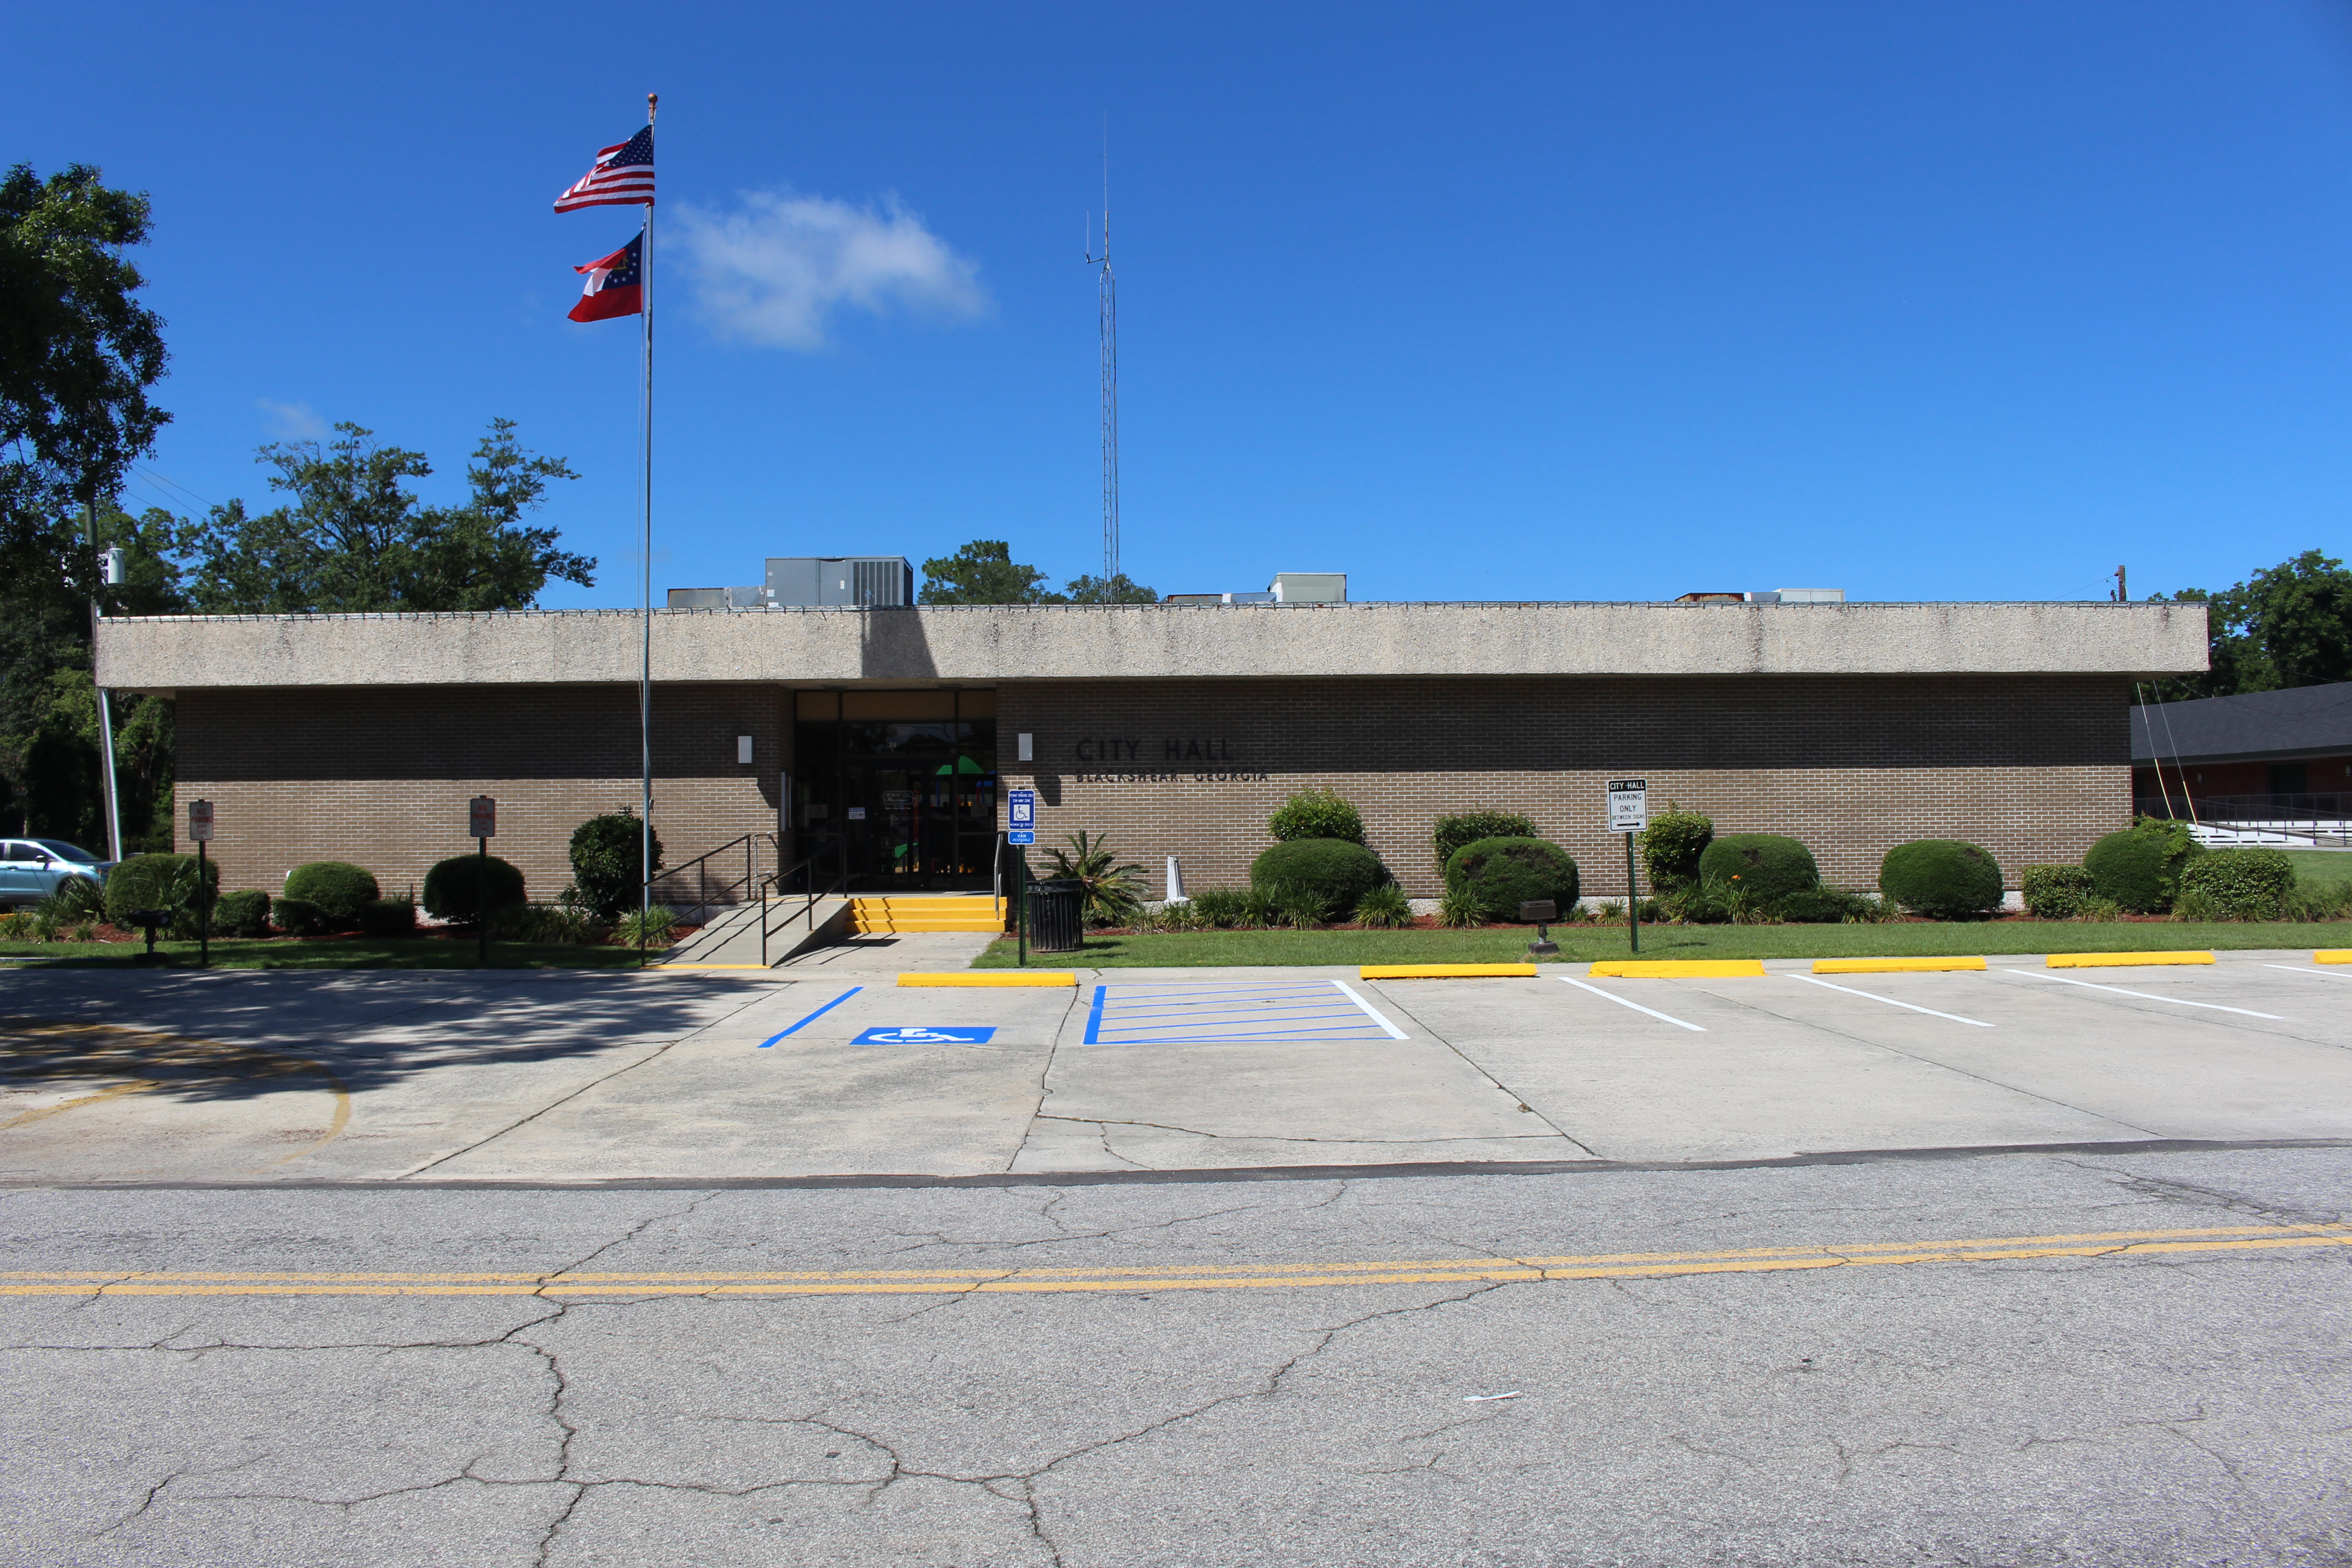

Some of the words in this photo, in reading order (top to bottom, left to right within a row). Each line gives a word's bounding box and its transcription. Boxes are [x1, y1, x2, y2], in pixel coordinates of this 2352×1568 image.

[1076, 739, 1140, 761] CITY
[1165, 739, 1233, 760] HALL
[1193, 769, 1269, 782] GEORGIA
[1614, 793, 1642, 801] PARKING
